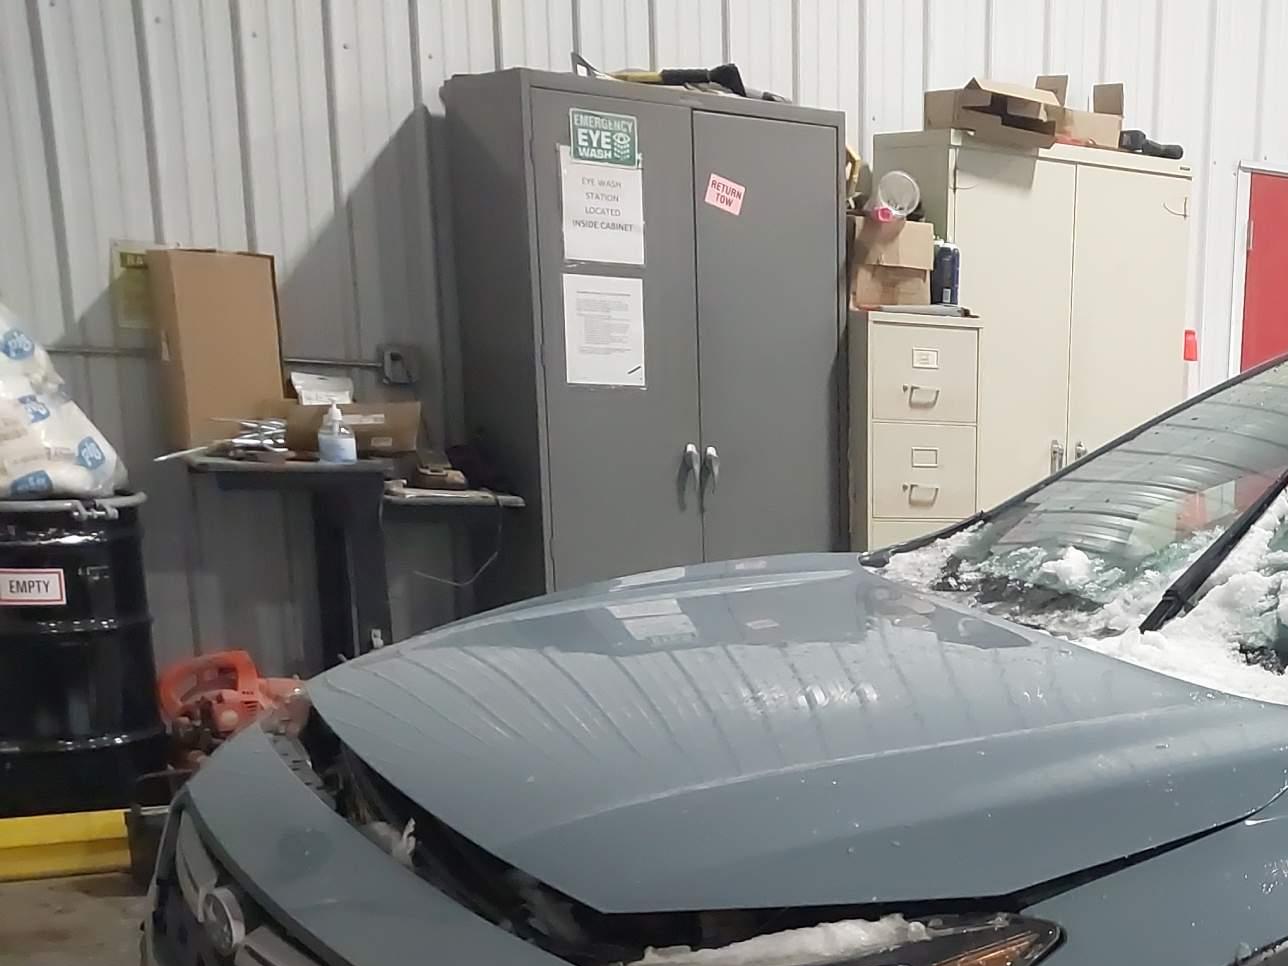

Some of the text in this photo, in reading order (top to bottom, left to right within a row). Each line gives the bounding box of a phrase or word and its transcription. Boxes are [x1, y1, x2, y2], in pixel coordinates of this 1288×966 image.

[573, 113, 633, 133] EMERGENCY
[577, 128, 612, 149] EYE
[577, 146, 612, 160] WASH
[581, 177, 622, 189] EYE WASH
[710, 179, 742, 200] RETURN
[585, 192, 619, 202] STATION
[715, 193, 734, 207] TOW
[585, 206, 621, 217] LOCATED
[573, 219, 633, 232] INSIDE CABINET
[8, 579, 50, 593] EMPTY
